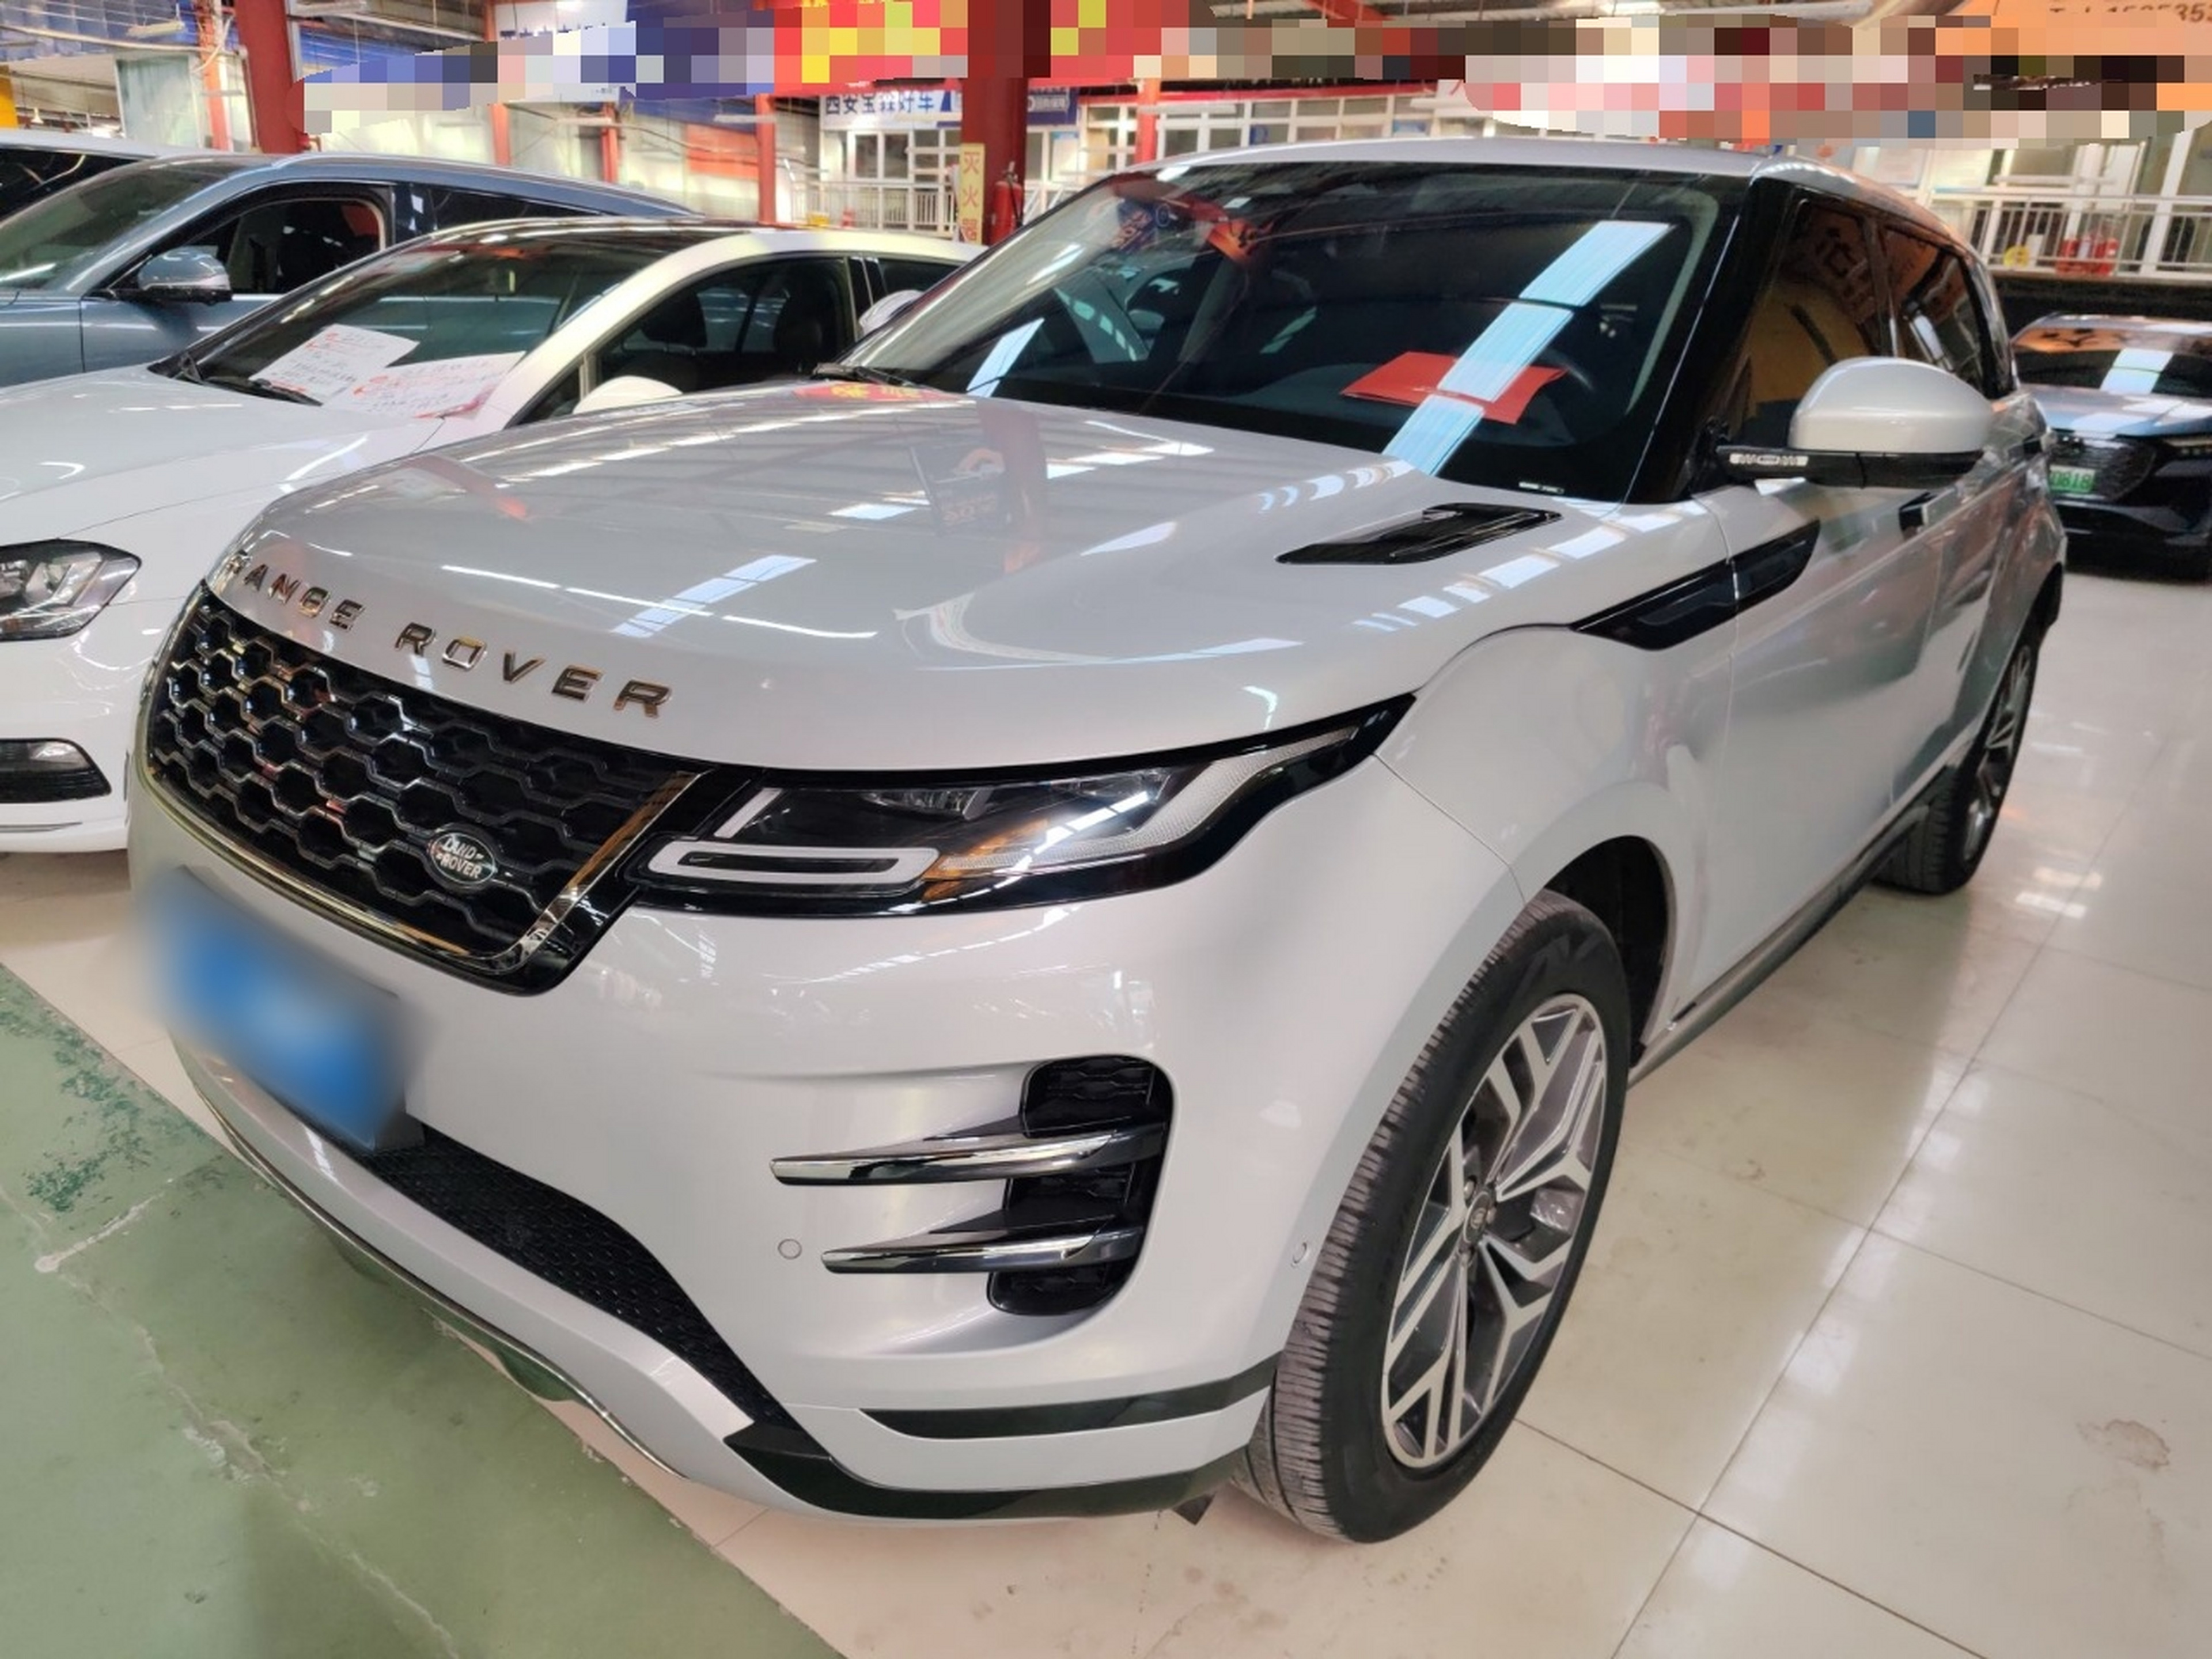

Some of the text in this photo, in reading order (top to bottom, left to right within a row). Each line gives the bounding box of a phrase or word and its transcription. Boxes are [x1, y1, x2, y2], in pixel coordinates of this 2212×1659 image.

[962, 151, 980, 241] 灭火器
[395, 622, 673, 718] ROVER
[440, 853, 482, 878] ROVER
[442, 835, 477, 860] LAND
